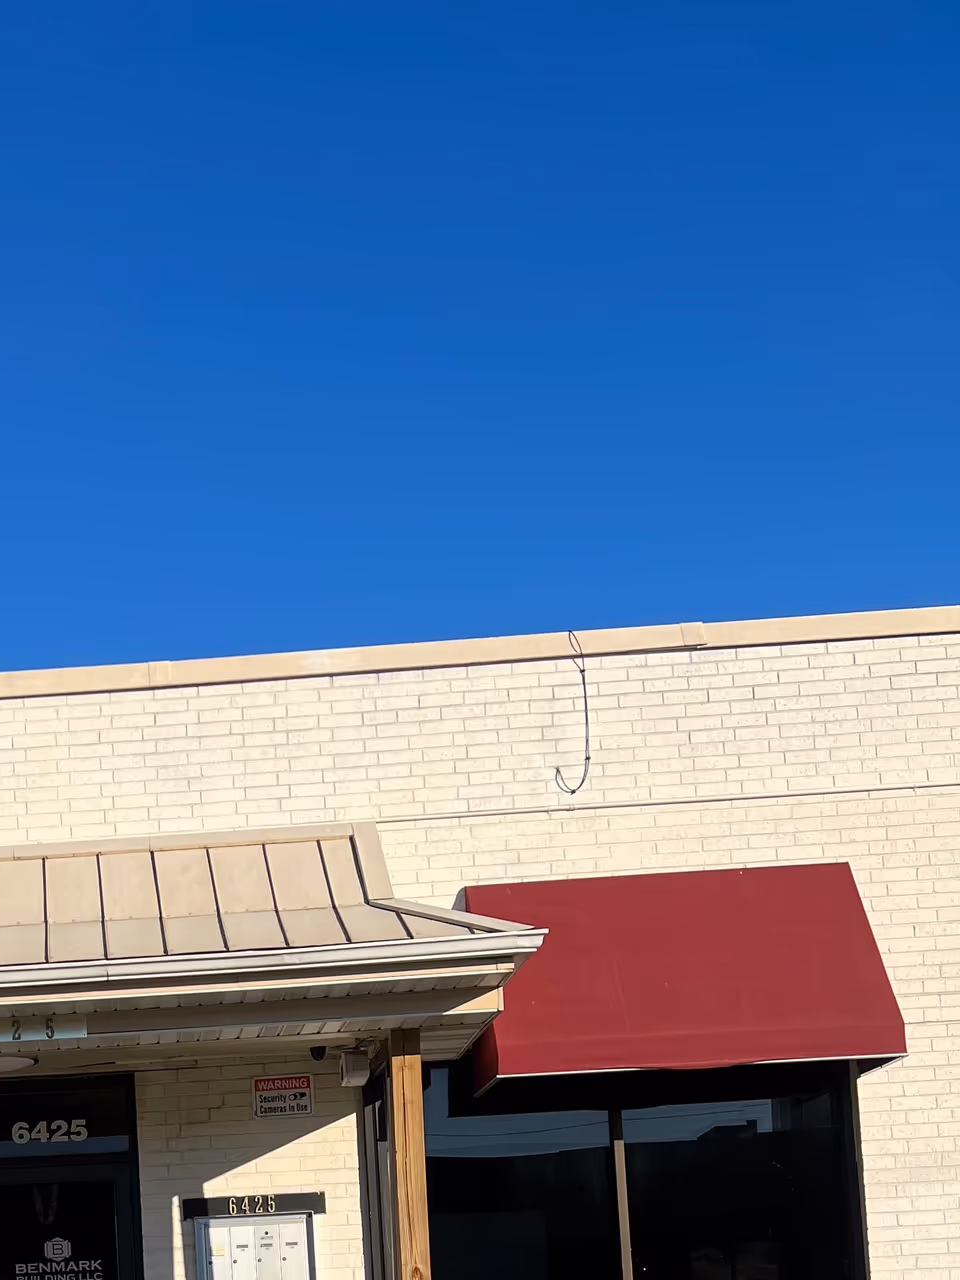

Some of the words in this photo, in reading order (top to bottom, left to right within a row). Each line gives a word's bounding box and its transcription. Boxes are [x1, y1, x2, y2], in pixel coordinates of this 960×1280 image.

[257, 1078, 308, 1091] WARNING
[259, 1093, 287, 1104] Security
[259, 1104, 287, 1115] Cameras
[288, 1104, 295, 1113] In
[296, 1103, 308, 1112] Use
[11, 1119, 89, 1145] 6425
[228, 1194, 277, 1215] 6425
[15, 1259, 103, 1274] BENMARK
